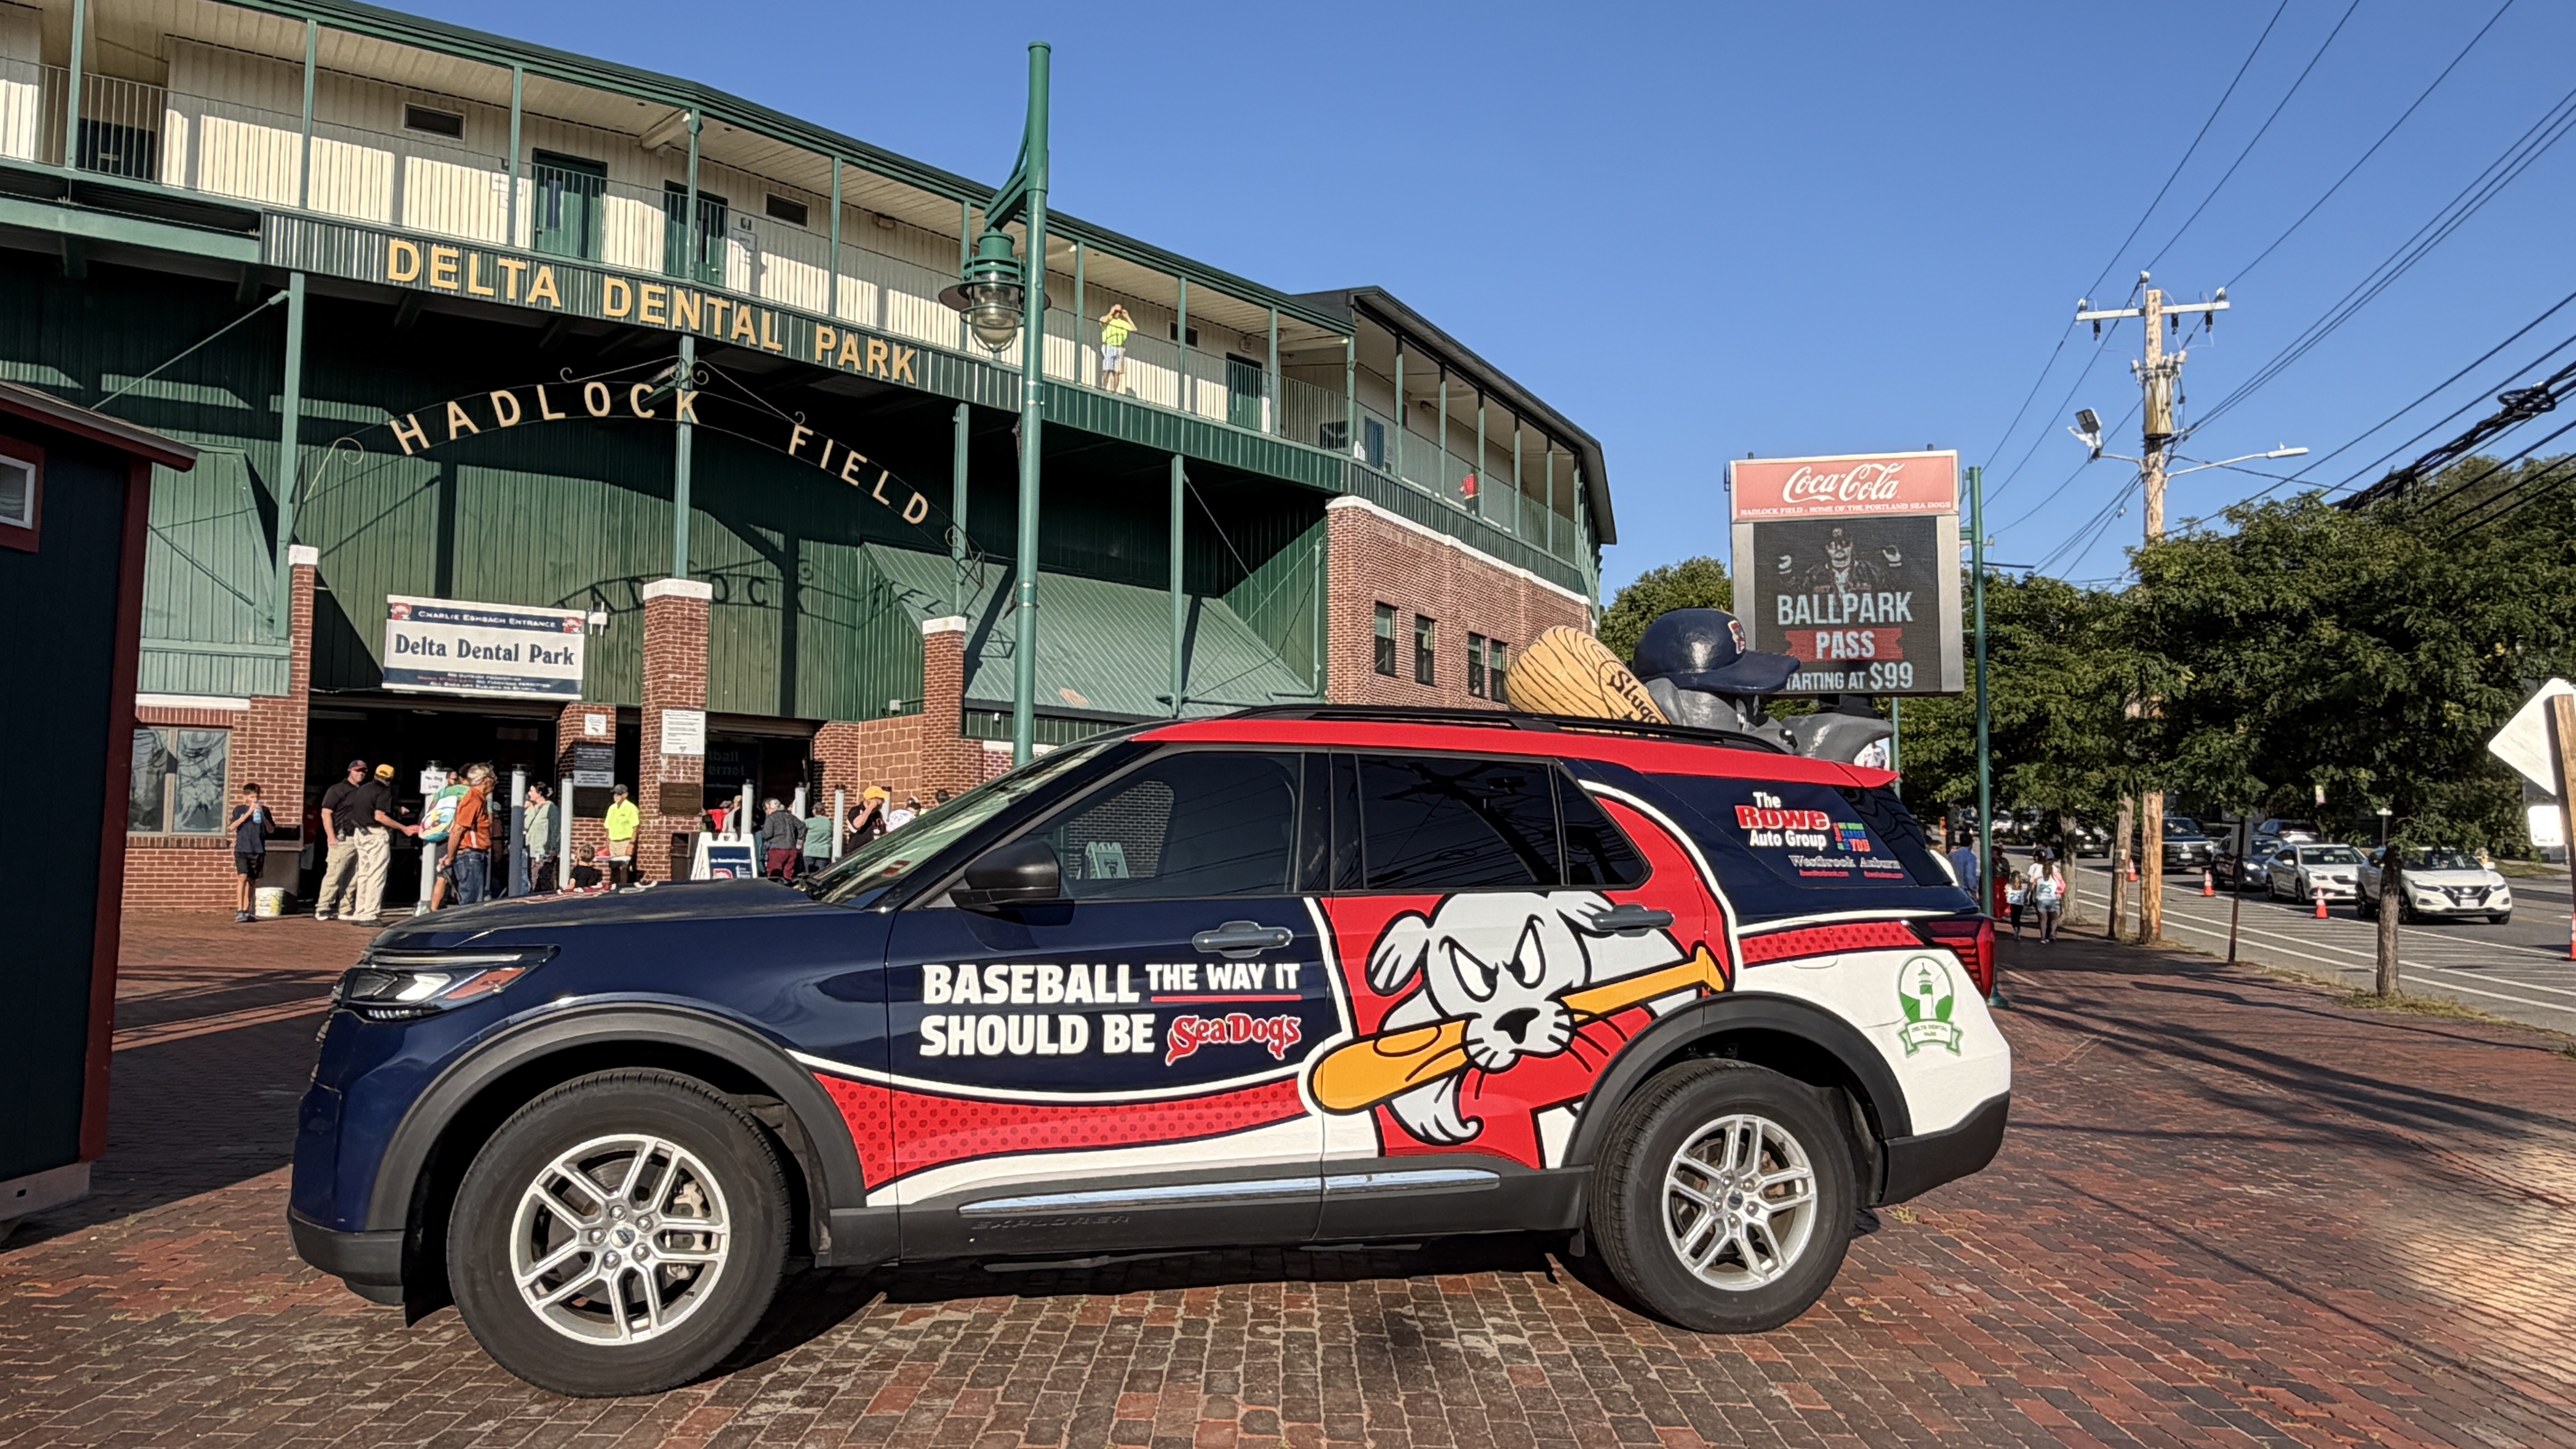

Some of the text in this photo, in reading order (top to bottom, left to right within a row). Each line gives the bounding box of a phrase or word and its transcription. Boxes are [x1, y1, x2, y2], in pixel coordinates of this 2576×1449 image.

[388, 239, 916, 384] DELTA DENTAL PARK
[389, 382, 929, 525] HADLOCK FIELD
[1783, 462, 1905, 503] Coca-Cola
[1809, 505, 1833, 513] HOME
[1865, 502, 1909, 511] PORTLAND
[509, 617, 556, 628] ENTRANCE
[1777, 591, 1913, 626] BALLPARK
[395, 634, 574, 666] Delta Dental Park
[1816, 631, 1875, 659] PASS
[1786, 662, 1913, 690] ARTING AT $99
[1753, 791, 1781, 808] The
[1749, 830, 1782, 847] Auto
[1785, 831, 1827, 851] Group
[922, 963, 1300, 1004] BASEBALL THE WAY IT
[920, 1013, 1155, 1056] SHOULD BE
